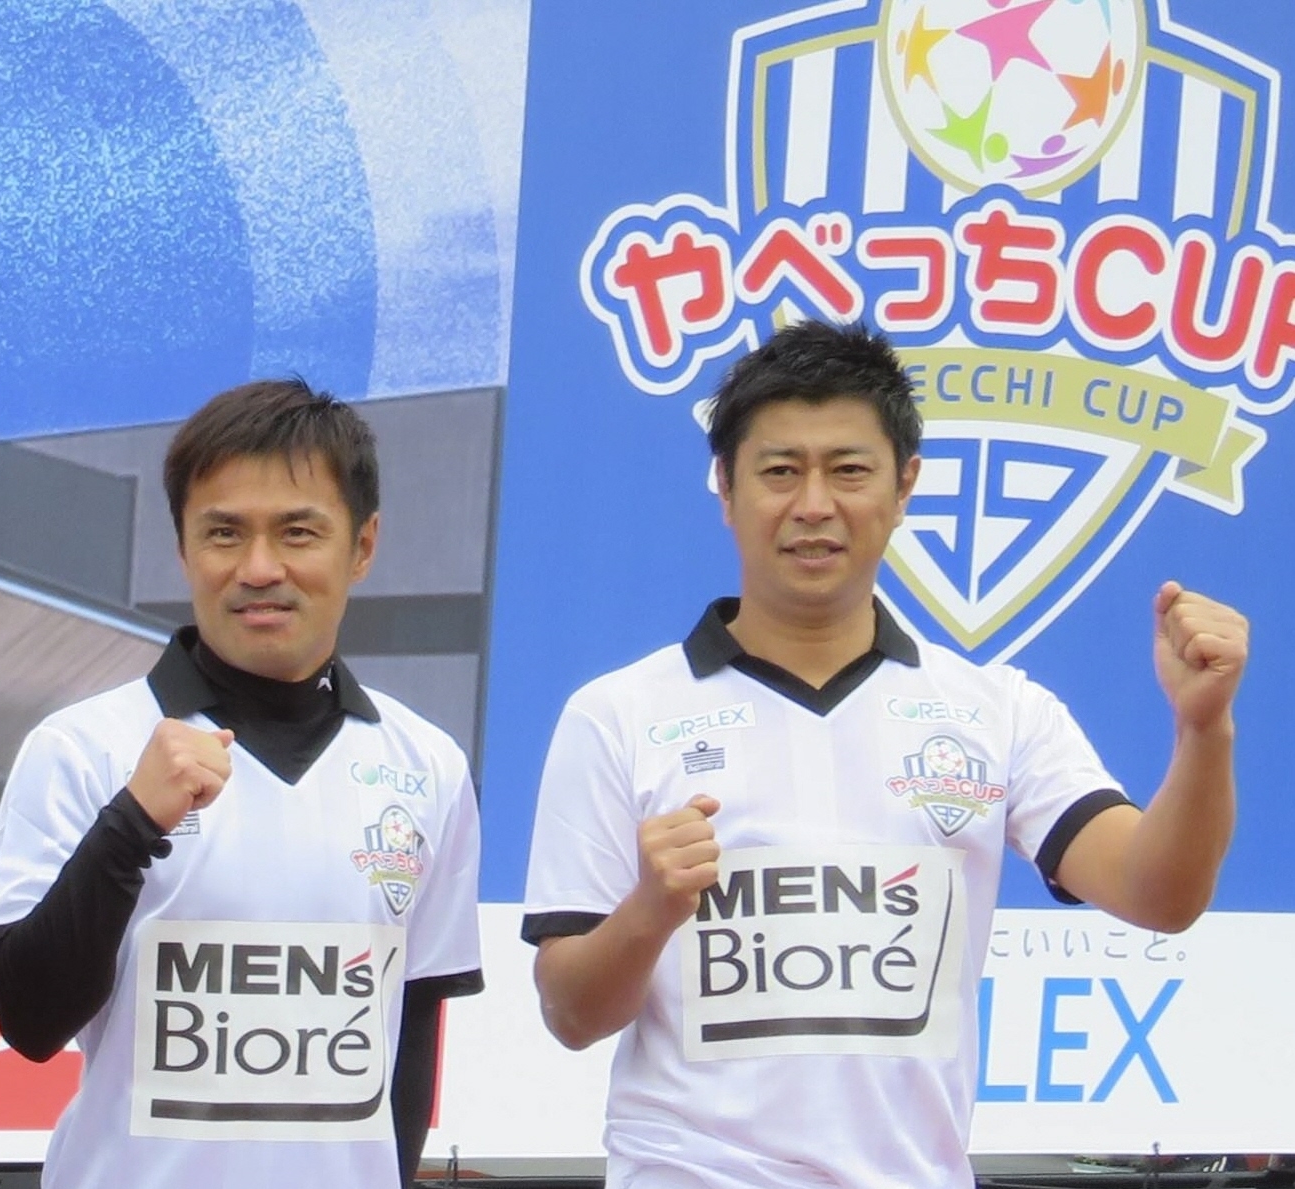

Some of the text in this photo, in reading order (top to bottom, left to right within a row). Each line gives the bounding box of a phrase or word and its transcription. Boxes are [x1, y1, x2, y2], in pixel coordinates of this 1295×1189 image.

[1082, 378, 1185, 432] CUP
[696, 923, 917, 998] Bioré
[152, 999, 371, 1076] Bioré
